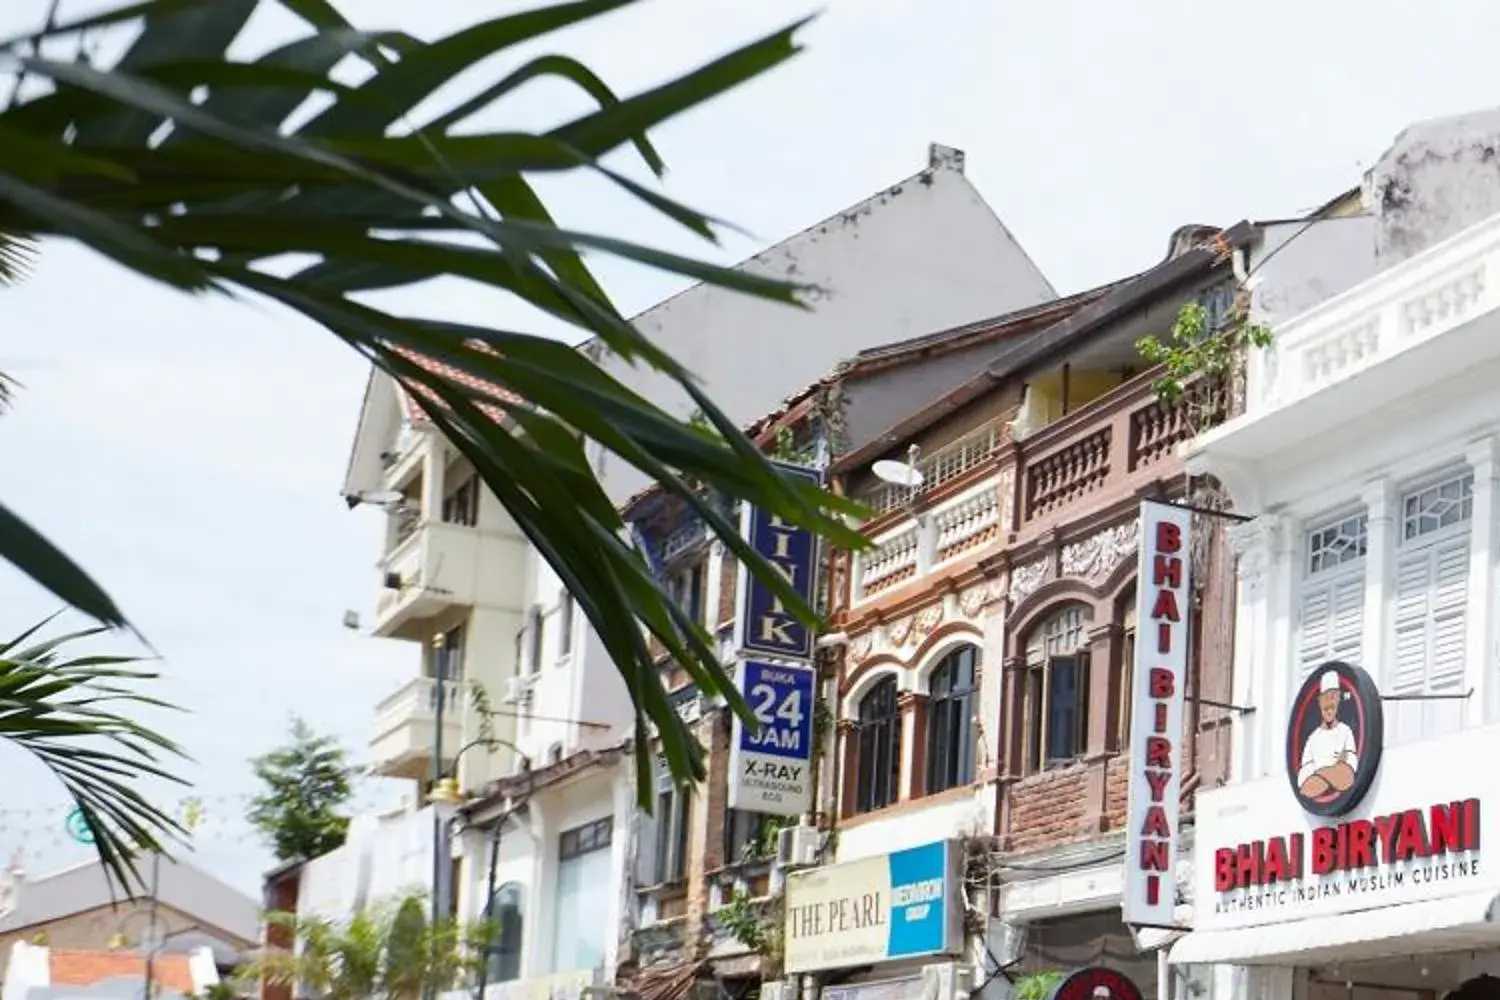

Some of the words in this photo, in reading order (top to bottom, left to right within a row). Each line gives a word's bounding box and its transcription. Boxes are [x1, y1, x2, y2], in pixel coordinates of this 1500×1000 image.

[1151, 520, 1182, 654] BHAI
[751, 683, 804, 729] 24
[749, 724, 801, 750] JAM
[744, 758, 802, 781] X-RAY
[1139, 667, 1175, 906] BIRYANI
[1215, 833, 1304, 892] BHAI
[1312, 798, 1480, 876] BIRYANI
[1215, 891, 1286, 914] AUTHENTIC
[1292, 880, 1342, 903] INDIAN
[1348, 871, 1404, 893] MUSLIM
[1412, 859, 1480, 884] CUISINE
[789, 902, 825, 939] THE
[828, 890, 887, 933] PEARL
